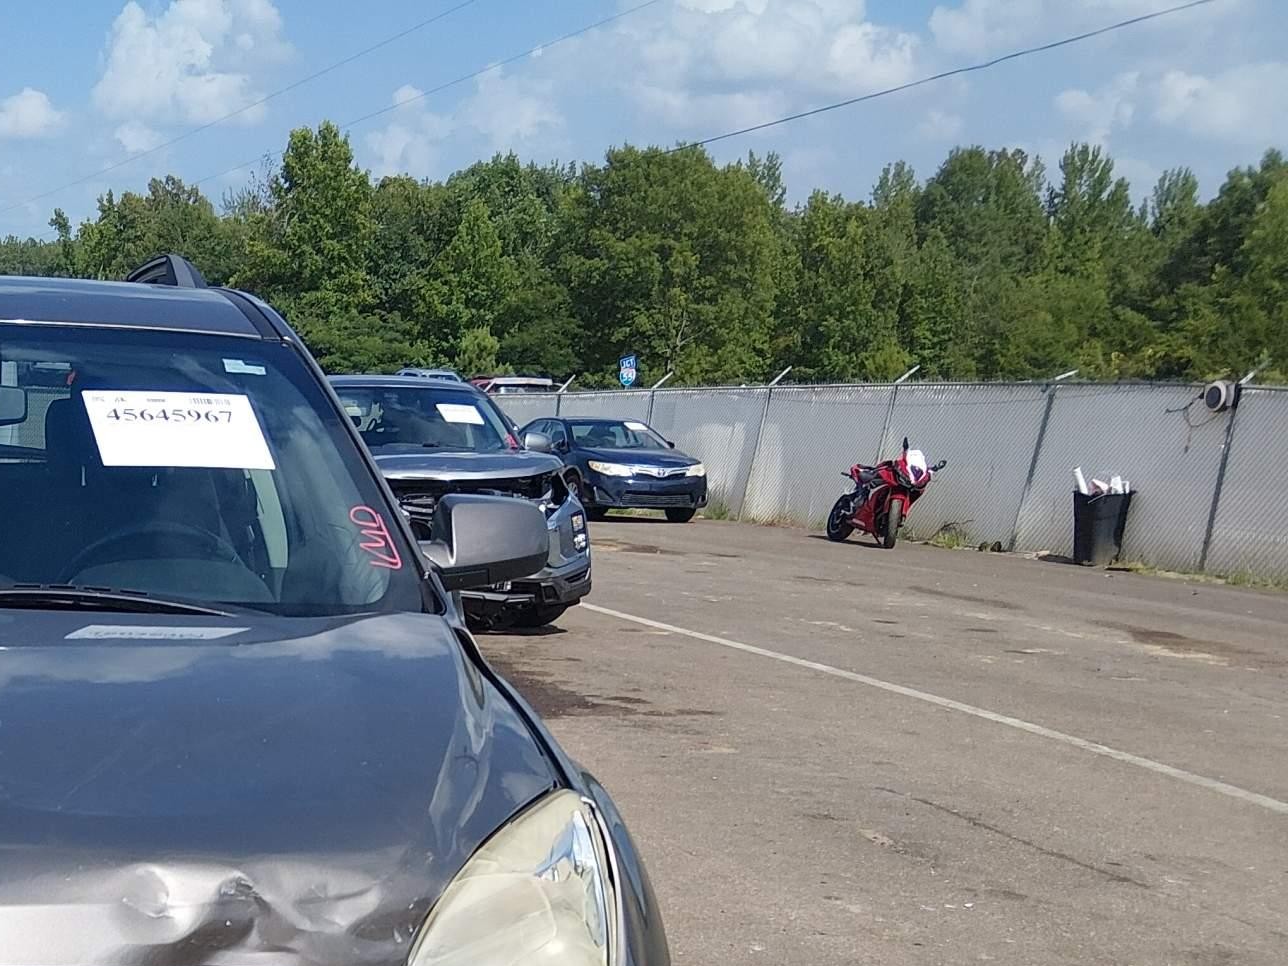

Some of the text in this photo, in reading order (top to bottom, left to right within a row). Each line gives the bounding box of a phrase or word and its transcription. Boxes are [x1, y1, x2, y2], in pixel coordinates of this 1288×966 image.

[621, 359, 634, 368] JCT
[621, 372, 633, 381] 55
[106, 408, 232, 424] 45645967
